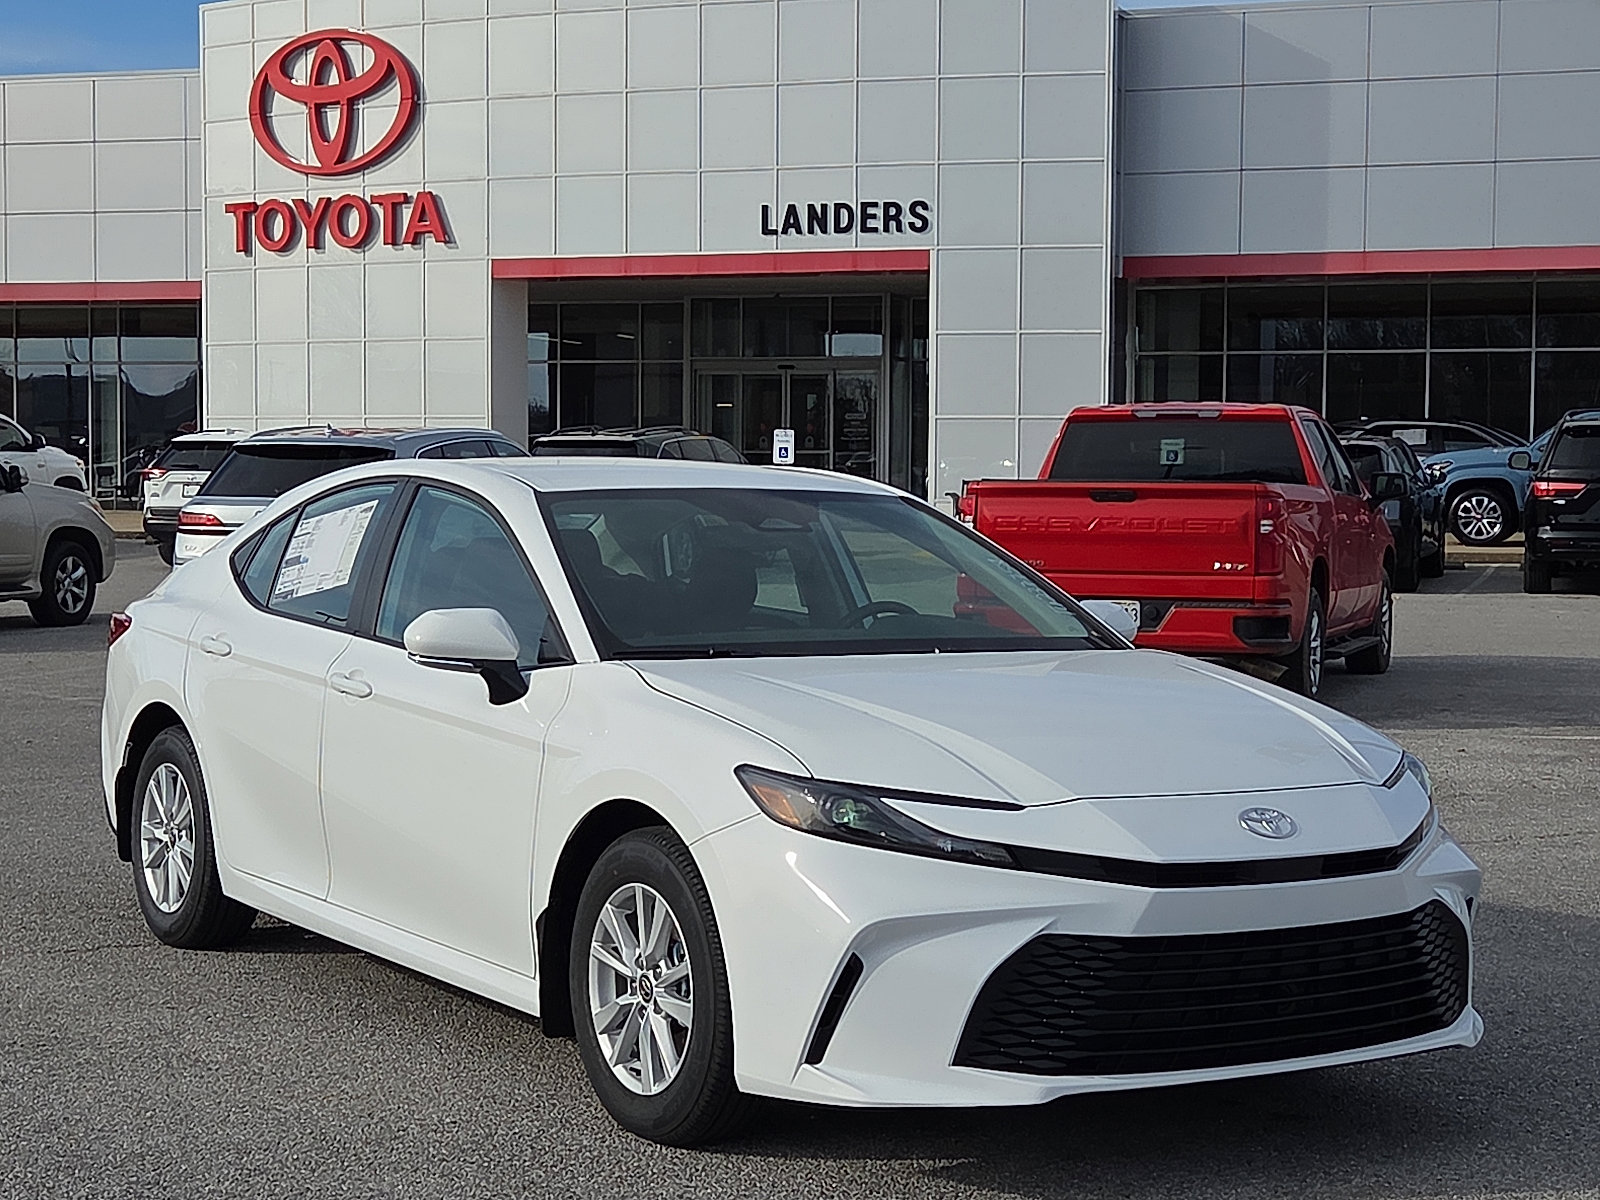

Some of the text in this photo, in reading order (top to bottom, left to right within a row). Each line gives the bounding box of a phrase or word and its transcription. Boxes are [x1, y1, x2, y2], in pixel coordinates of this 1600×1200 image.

[225, 191, 448, 252] TOYOTA
[761, 200, 930, 236] LANDERS
[993, 515, 1236, 533] CHEVROLET
